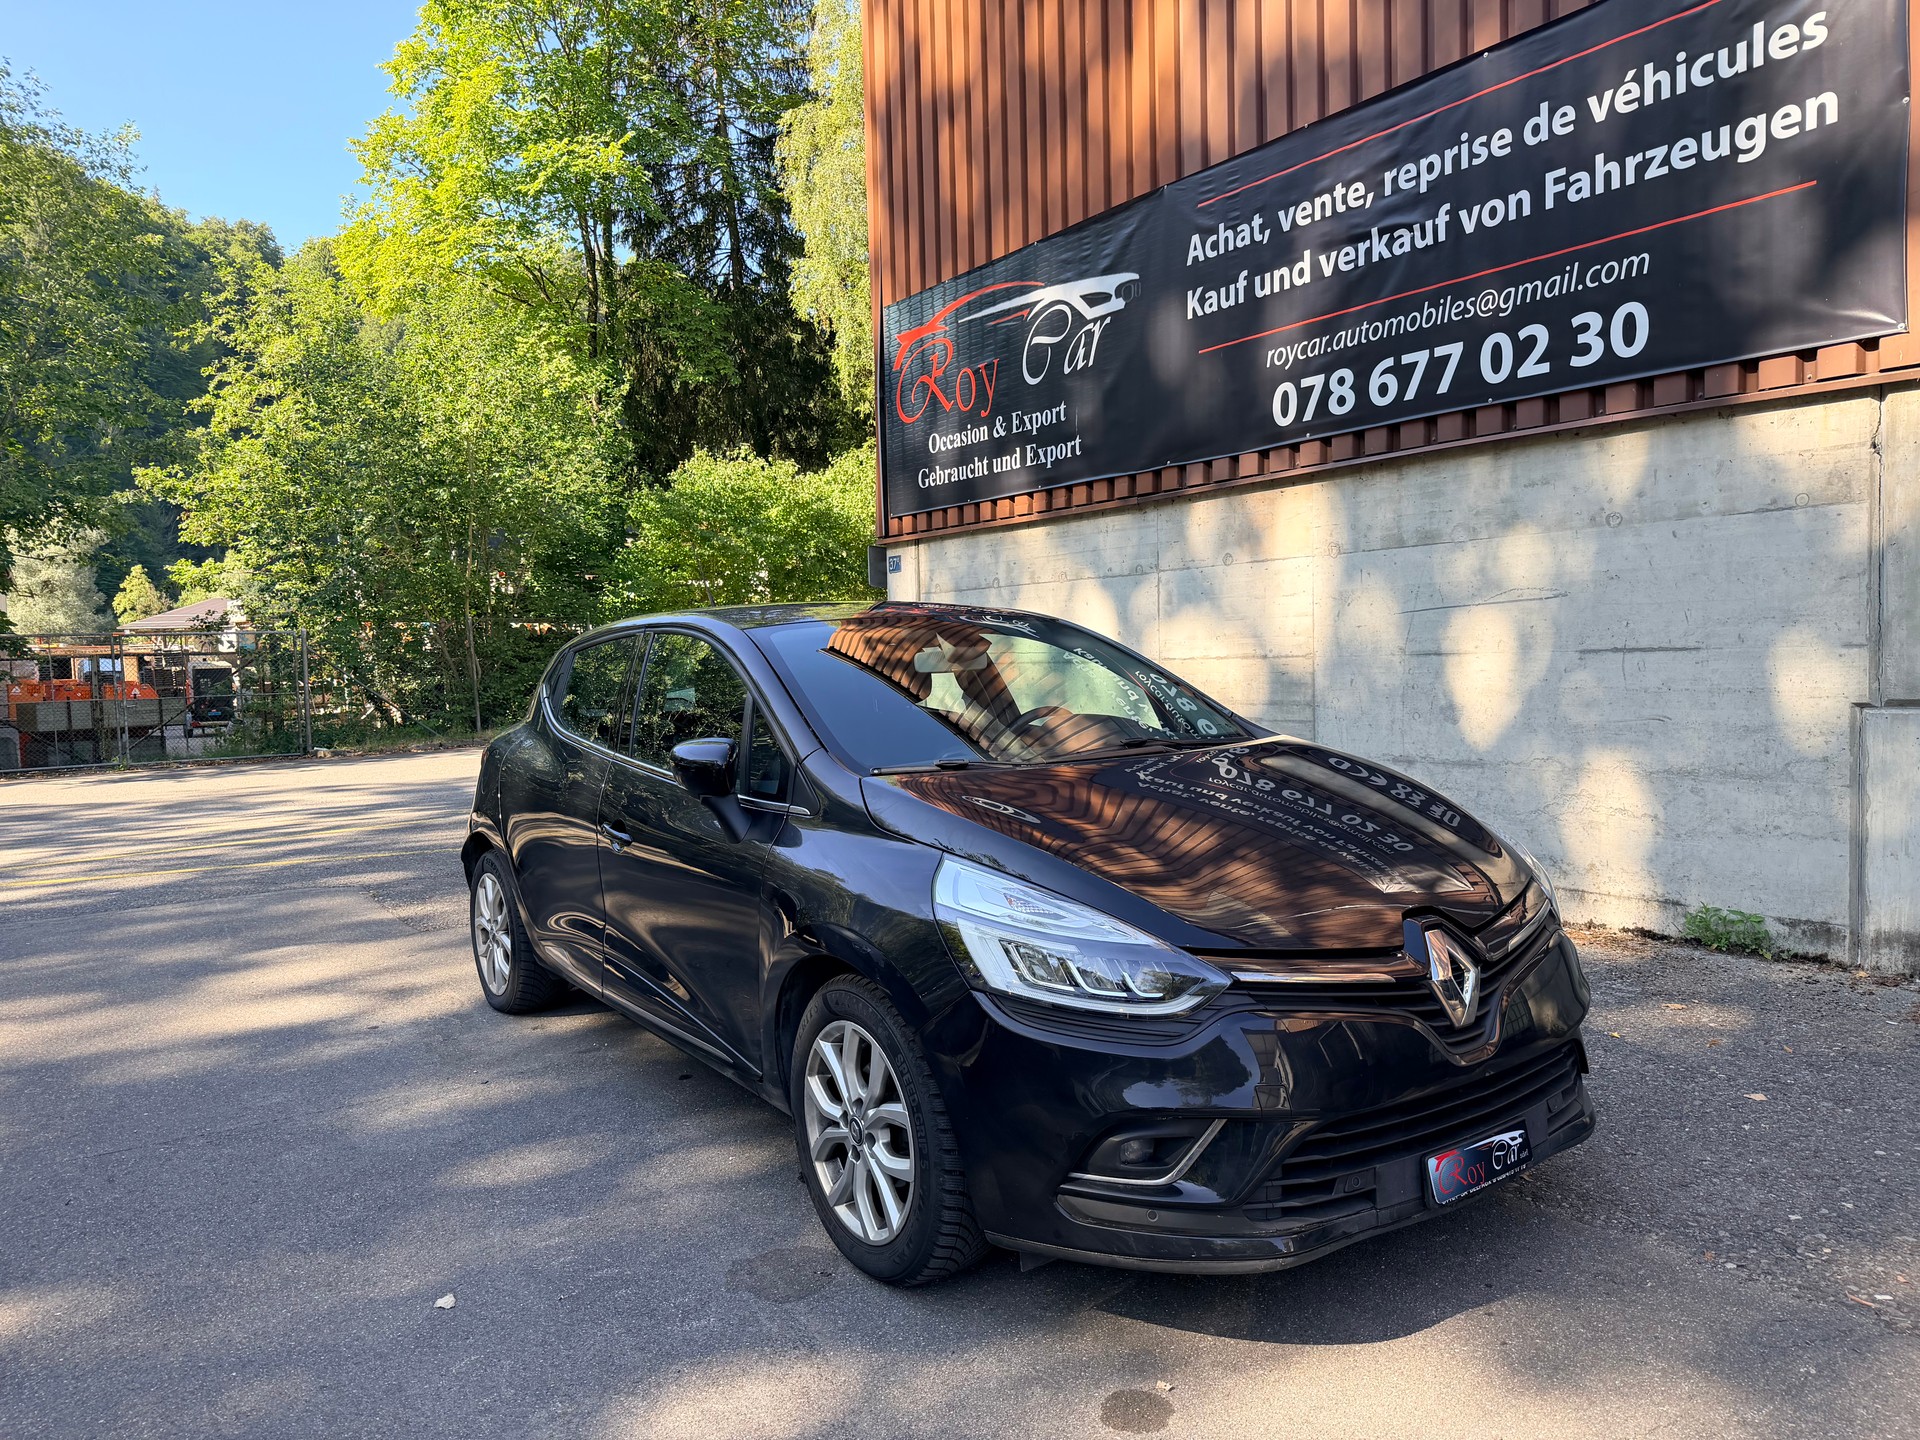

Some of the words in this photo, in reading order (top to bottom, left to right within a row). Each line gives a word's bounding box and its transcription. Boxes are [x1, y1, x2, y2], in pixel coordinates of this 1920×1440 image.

[1186, 213, 1271, 266] Achat,
[1278, 181, 1375, 233] vente,
[1383, 127, 1513, 197] reprise
[1522, 101, 1576, 146] de
[1586, 11, 1829, 123] véhicules
[1186, 270, 1248, 320] Kauf
[1254, 249, 1311, 298] und
[1318, 202, 1451, 278] verkauf
[1458, 189, 1531, 234] von
[1544, 90, 1839, 210] Fahrzeugen
[896, 337, 1000, 423] Roy
[1022, 303, 1111, 386] Car
[1266, 252, 1650, 370] roycar.automobiles@gmail.com
[1271, 367, 1356, 427] 078
[1368, 341, 1464, 407] 677
[1479, 323, 1550, 385] 02
[1569, 301, 1650, 367] 30
[918, 457, 989, 488] Gebraucht
[992, 447, 1021, 473] und
[1025, 434, 1082, 469] Export
[928, 423, 989, 454] Occasion
[992, 415, 1007, 439] &
[1011, 400, 1067, 436] Export
[1438, 1155, 1485, 1194] Roy
[1492, 1140, 1520, 1170] Car
